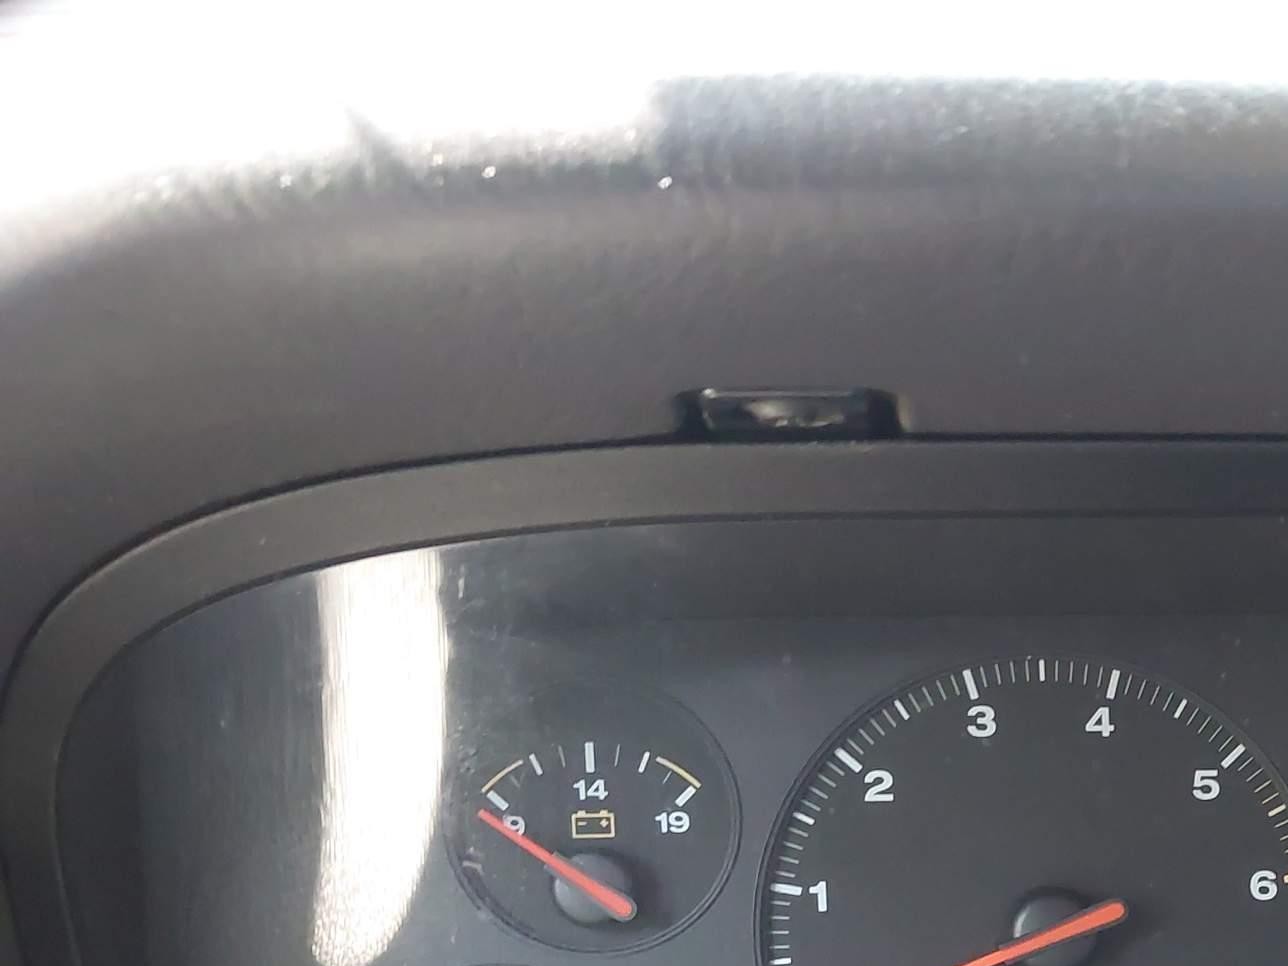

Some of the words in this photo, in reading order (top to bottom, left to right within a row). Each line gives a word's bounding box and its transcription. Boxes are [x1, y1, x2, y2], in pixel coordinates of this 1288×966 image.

[967, 706, 996, 737] 3
[1086, 707, 1114, 737] 4
[573, 780, 608, 800] 14
[864, 770, 894, 802] 2
[1193, 770, 1219, 800] 5
[503, 815, 525, 836] 9
[655, 812, 689, 833] 19
[809, 881, 827, 912] 1
[1250, 871, 1277, 900] 6
